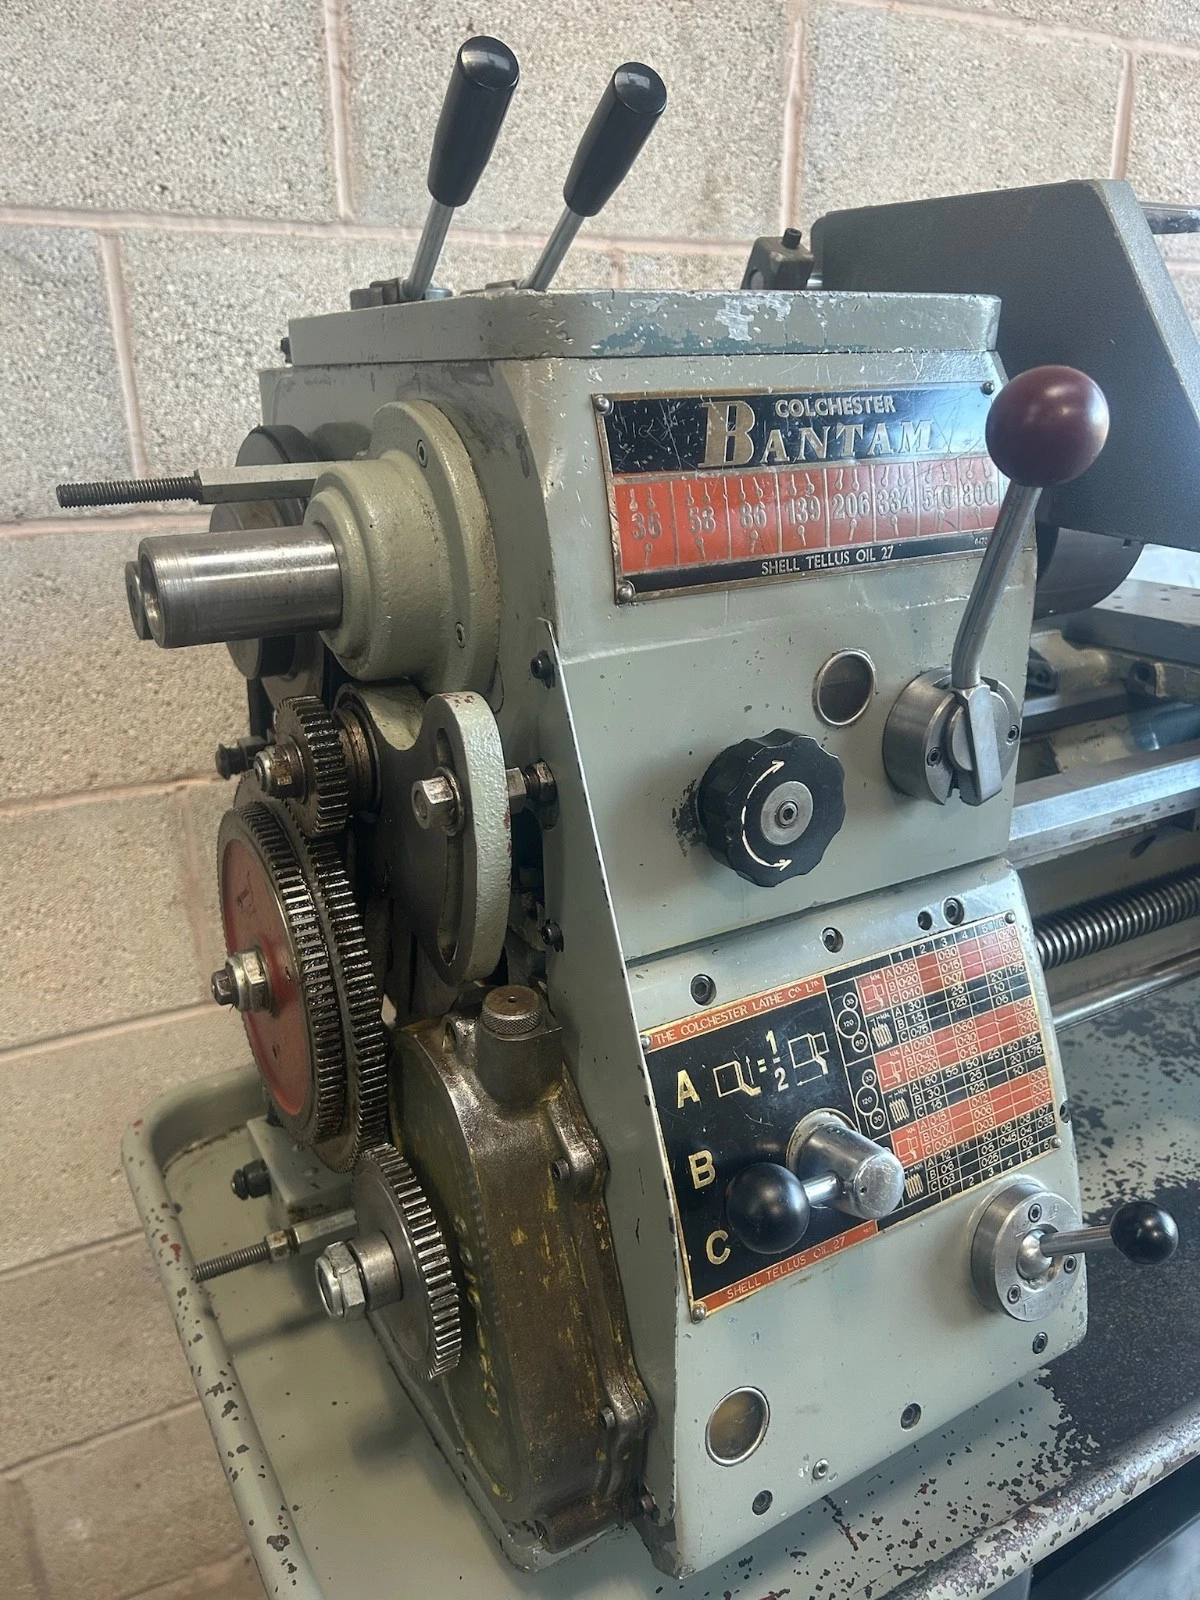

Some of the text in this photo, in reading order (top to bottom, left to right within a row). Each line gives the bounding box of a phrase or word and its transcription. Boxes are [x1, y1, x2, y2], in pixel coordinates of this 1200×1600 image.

[775, 395, 896, 417] COLCHESTER
[698, 400, 933, 467] BANTAM
[632, 480, 998, 540] 36 58 86 139 206 334 510 800
[761, 545, 894, 576] SHELL TELLUS OIL 27
[898, 952, 904, 960] 1
[920, 944, 926, 954] 2
[941, 937, 948, 946] 3
[962, 931, 968, 939] 4
[982, 924, 988, 933] 5
[886, 969, 894, 979] A
[888, 982, 897, 991] B
[892, 993, 899, 1004] C
[895, 1007, 902, 1016] A
[655, 1030, 677, 1045] THE
[680, 1004, 748, 1036] COLCHESTER
[752, 992, 784, 1011] LATHE
[897, 1020, 905, 1029] B
[900, 1031, 908, 1041] C
[766, 1030, 778, 1054] 1
[904, 1045, 911, 1054] A
[906, 1057, 914, 1066] B
[908, 1068, 916, 1079] C
[774, 1067, 789, 1092] 2
[678, 1069, 700, 1108] A
[912, 1082, 919, 1092] A
[914, 1095, 922, 1104] B
[916, 1107, 925, 1117] C
[920, 1120, 928, 1130] A
[922, 1132, 930, 1142] B
[925, 1144, 932, 1155] C
[927, 1157, 935, 1168] A
[968, 1176, 974, 1186] 2
[987, 1168, 994, 1176] 3
[1007, 1158, 1014, 1166] 4
[1026, 1150, 1033, 1158] 5
[1044, 1141, 1050, 1149] 6
[688, 1150, 716, 1189] B
[930, 1170, 937, 1180] B
[931, 1181, 938, 1191] C
[706, 1230, 731, 1265] C
[726, 1277, 762, 1300] SHELL
[766, 1254, 806, 1280] TELLUS
[832, 1236, 846, 1250] 27
